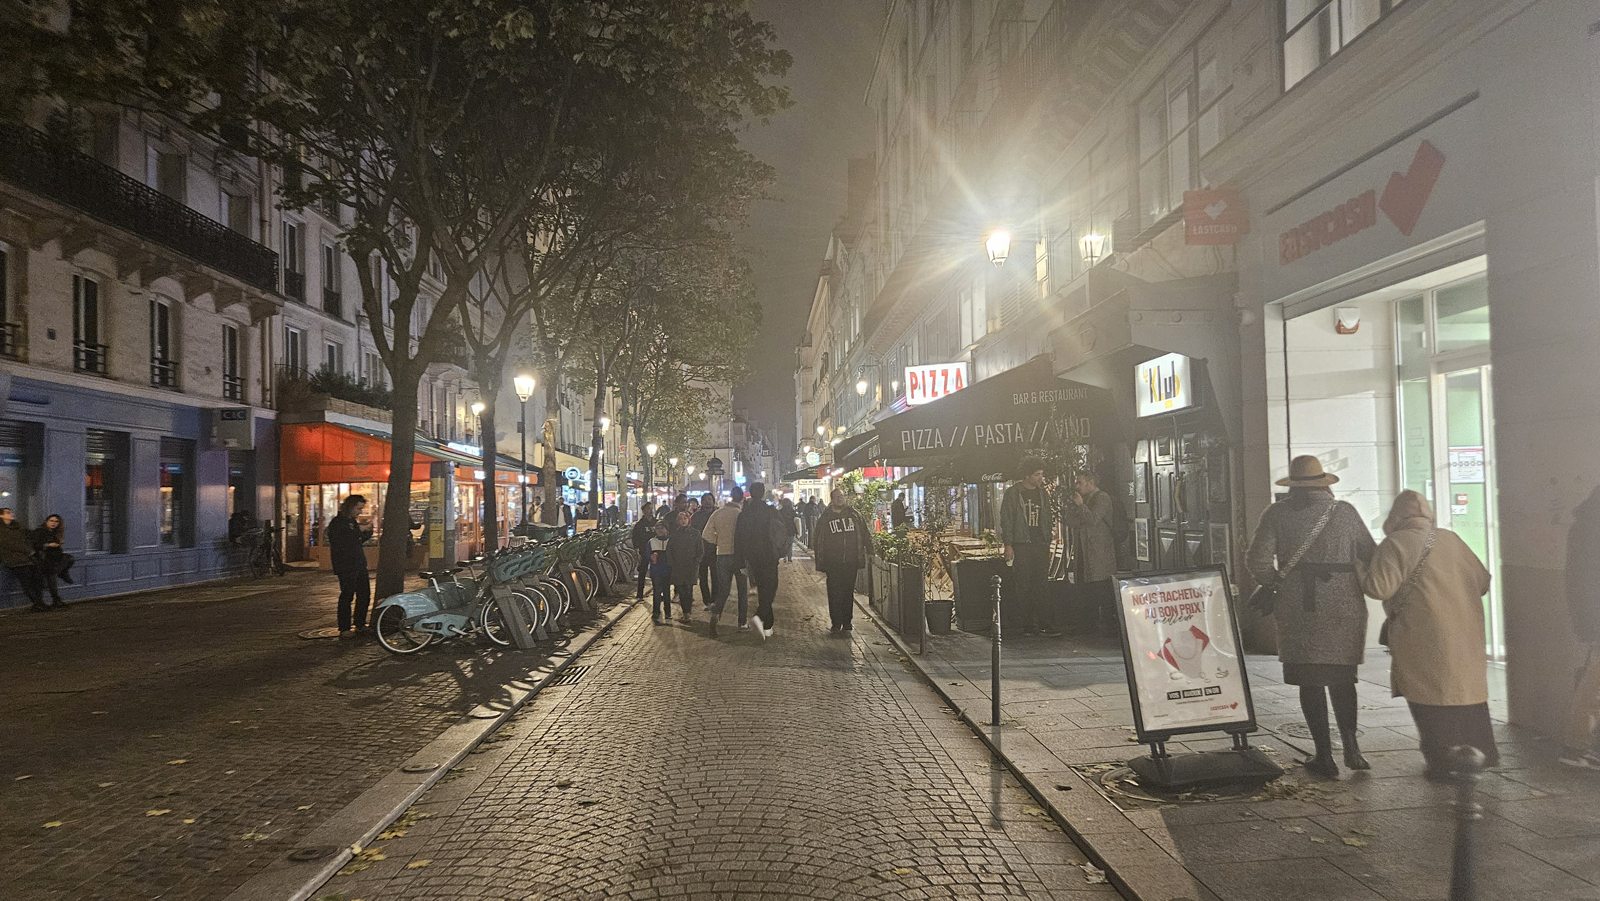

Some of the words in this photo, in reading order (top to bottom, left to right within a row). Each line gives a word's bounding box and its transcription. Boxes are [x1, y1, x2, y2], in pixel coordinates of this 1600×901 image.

[910, 368, 963, 399] PIZZA
[1013, 392, 1029, 405] BAR
[1031, 392, 1037, 403] &
[1039, 388, 1089, 403] RESTAURANT
[901, 428, 944, 451] PIZZA
[974, 422, 1024, 446] PASTA
[1054, 417, 1091, 440] VINO
[828, 517, 855, 534] UCLA
[1132, 592, 1158, 606] NOUS
[1144, 607, 1157, 619] AU
[1159, 604, 1179, 618] BON
[1179, 602, 1202, 615] PRIX
